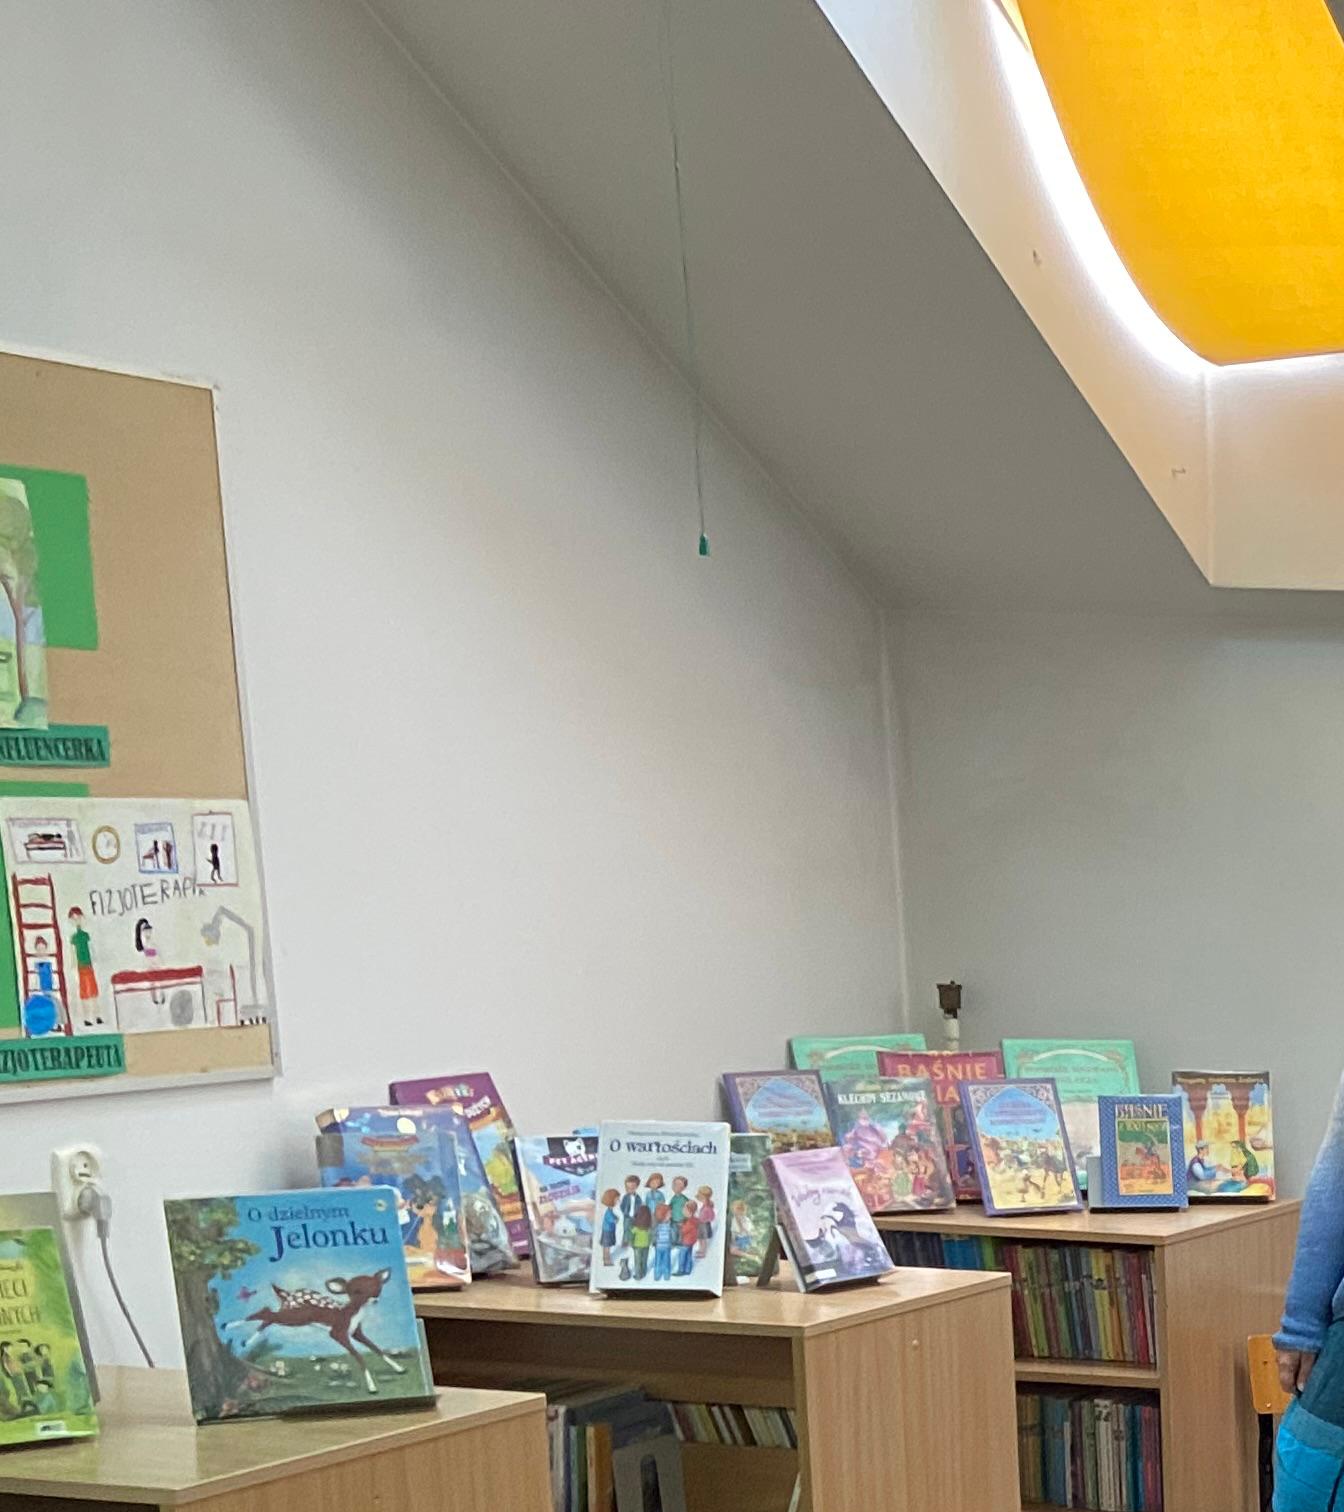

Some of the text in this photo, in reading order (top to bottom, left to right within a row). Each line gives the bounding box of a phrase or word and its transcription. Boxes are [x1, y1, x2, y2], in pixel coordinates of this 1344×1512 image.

[897, 1059, 987, 1080] BAŚNIE
[609, 1138, 718, 1155] O wartościach
[248, 1204, 349, 1223] O dzielnym
[268, 1221, 389, 1262] Jelonku
